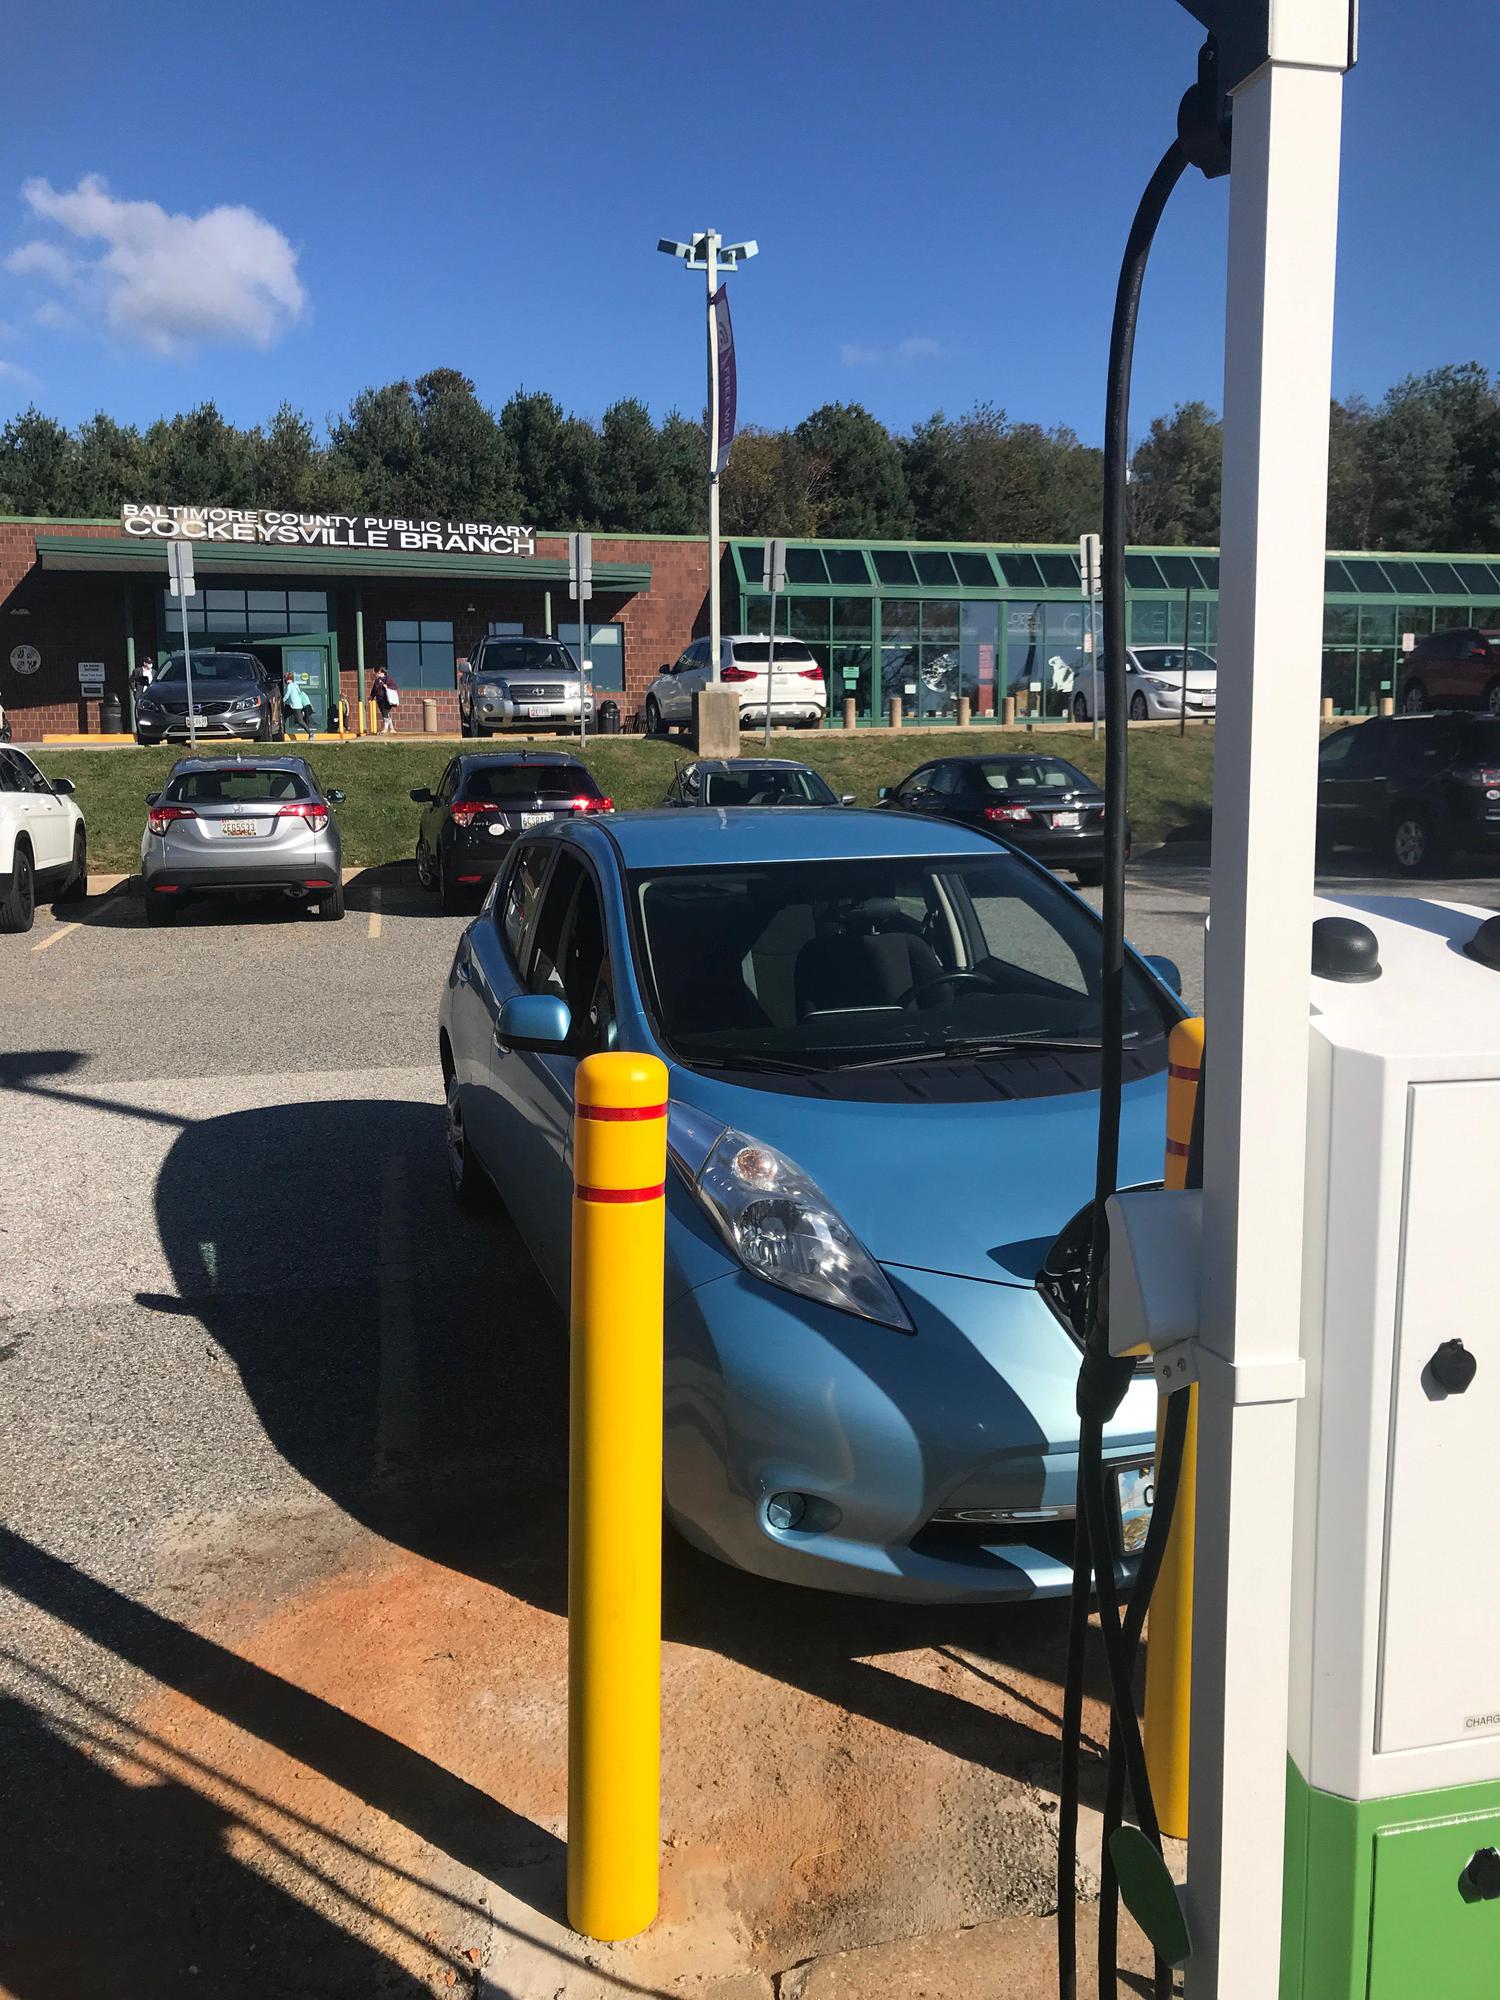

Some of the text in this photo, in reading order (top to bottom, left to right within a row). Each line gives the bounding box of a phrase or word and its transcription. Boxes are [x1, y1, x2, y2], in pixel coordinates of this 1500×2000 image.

[124, 504, 533, 538] BALTIMORE COUNTY PUBLIC LIBRARY
[124, 517, 535, 555] COCKEYSVILLE BRANCH
